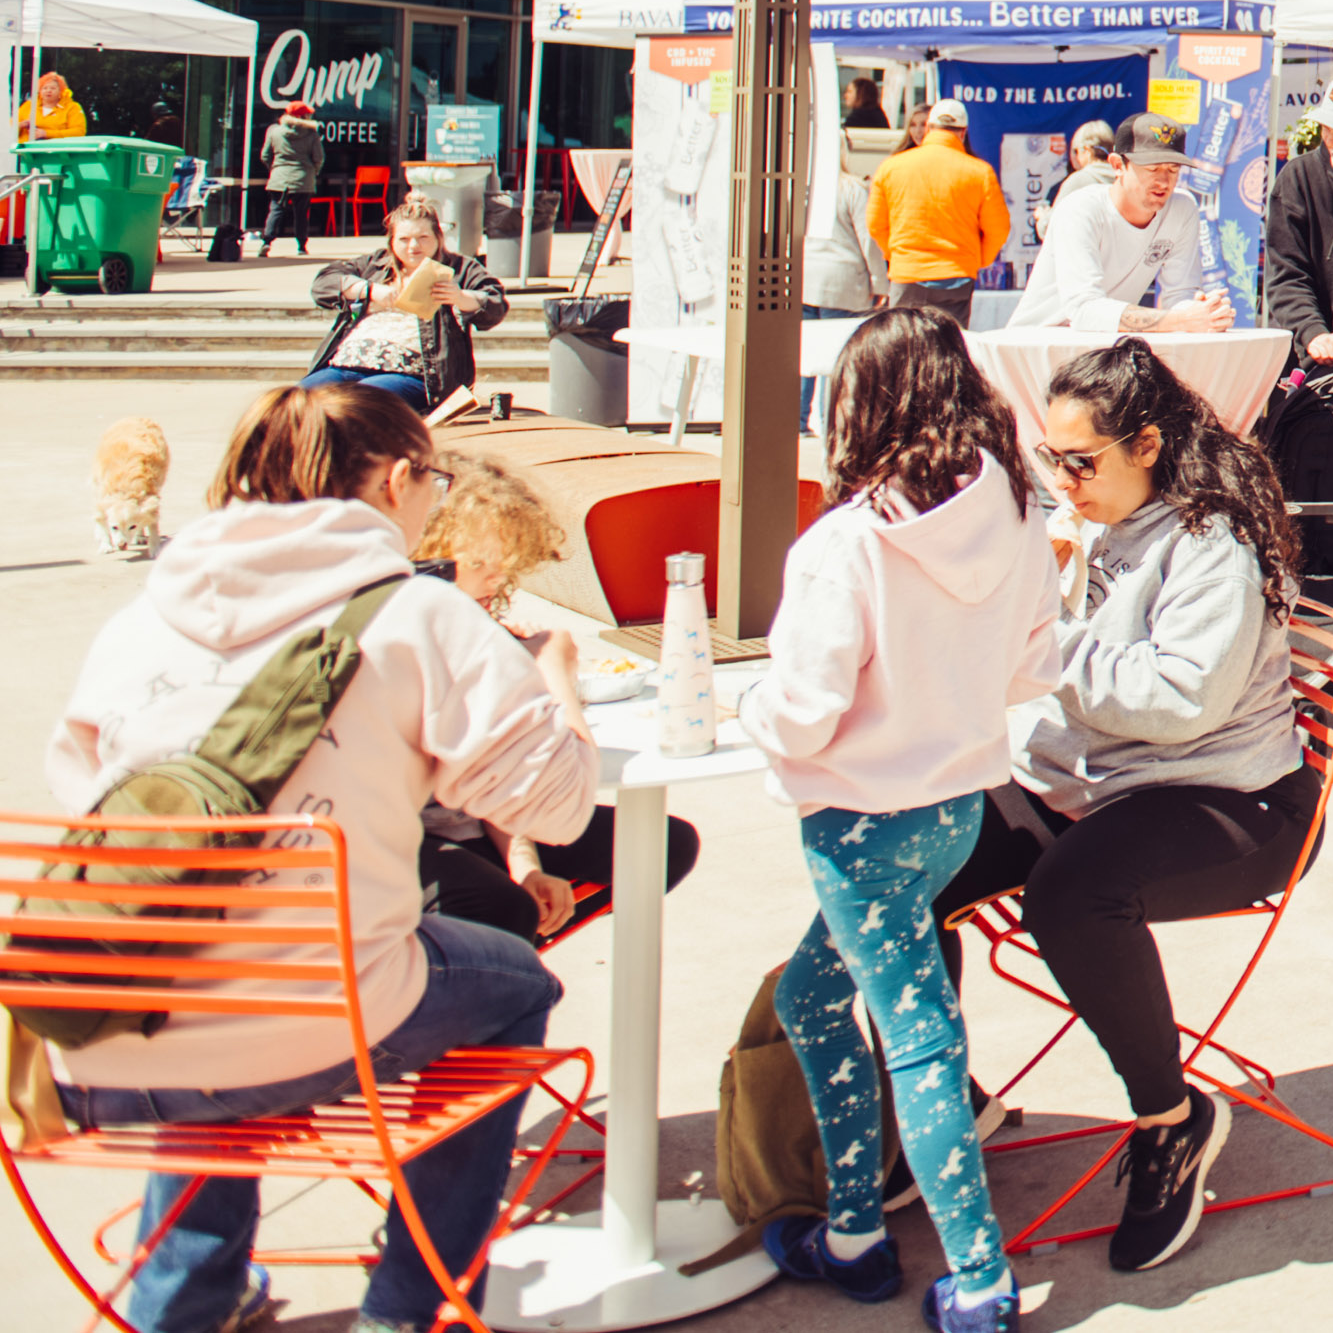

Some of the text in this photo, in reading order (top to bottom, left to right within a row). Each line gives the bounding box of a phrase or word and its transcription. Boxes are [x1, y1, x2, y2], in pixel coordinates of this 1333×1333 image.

[706, 1, 1199, 31] YO RITE COCKTAILS... Better THAN EVER
[1193, 45, 1247, 57] SPIRIT FREE
[1198, 56, 1240, 67] COCKTAIL
[671, 57, 712, 67] INFUSED
[953, 83, 1132, 104] HOLD THE ALCOHOL.
[1279, 92, 1326, 106] AVO
[318, 122, 378, 143] COFFEE
[1203, 106, 1231, 157] Better
[1022, 168, 1043, 248] Better
[1199, 218, 1216, 268] Better
